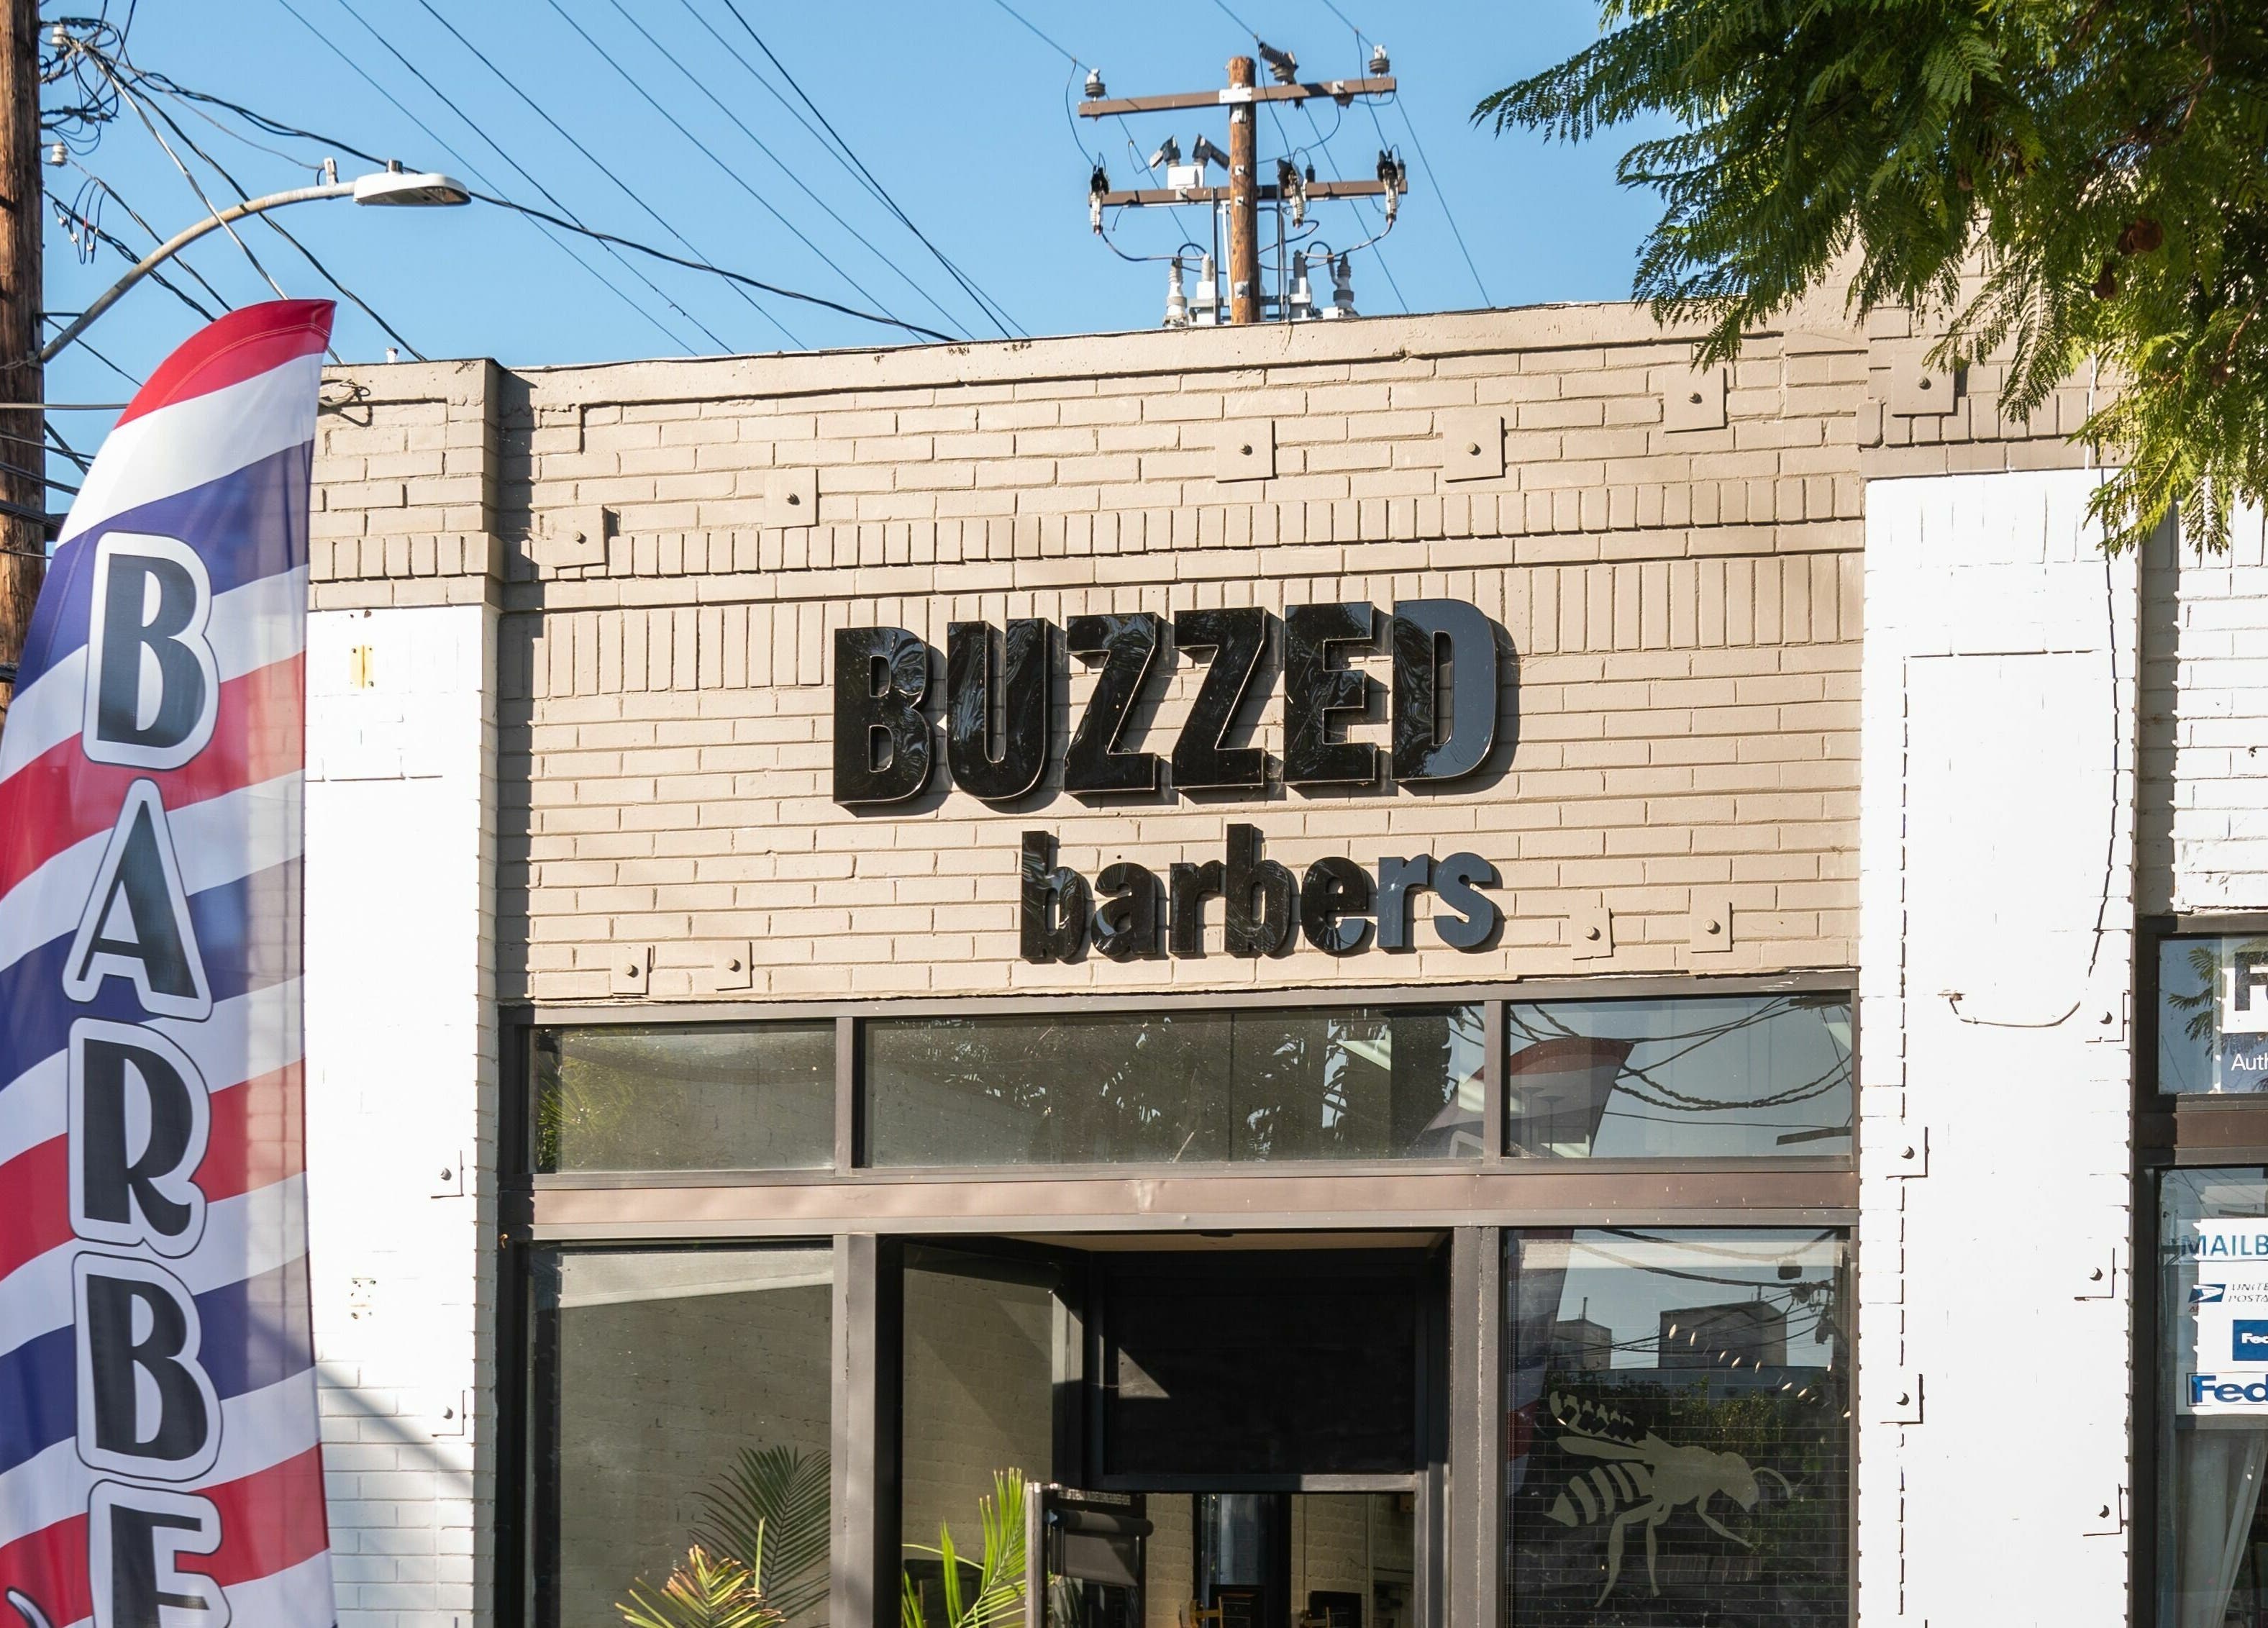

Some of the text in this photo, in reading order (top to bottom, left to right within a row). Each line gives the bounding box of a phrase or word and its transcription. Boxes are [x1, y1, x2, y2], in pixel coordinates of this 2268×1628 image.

[832, 598, 1503, 806] BUZZED
[1019, 823, 1496, 961] barbers
[2234, 951, 2268, 1011] F
[2181, 1234, 2268, 1256] MAILB
[2191, 1374, 2268, 1404] Fed
